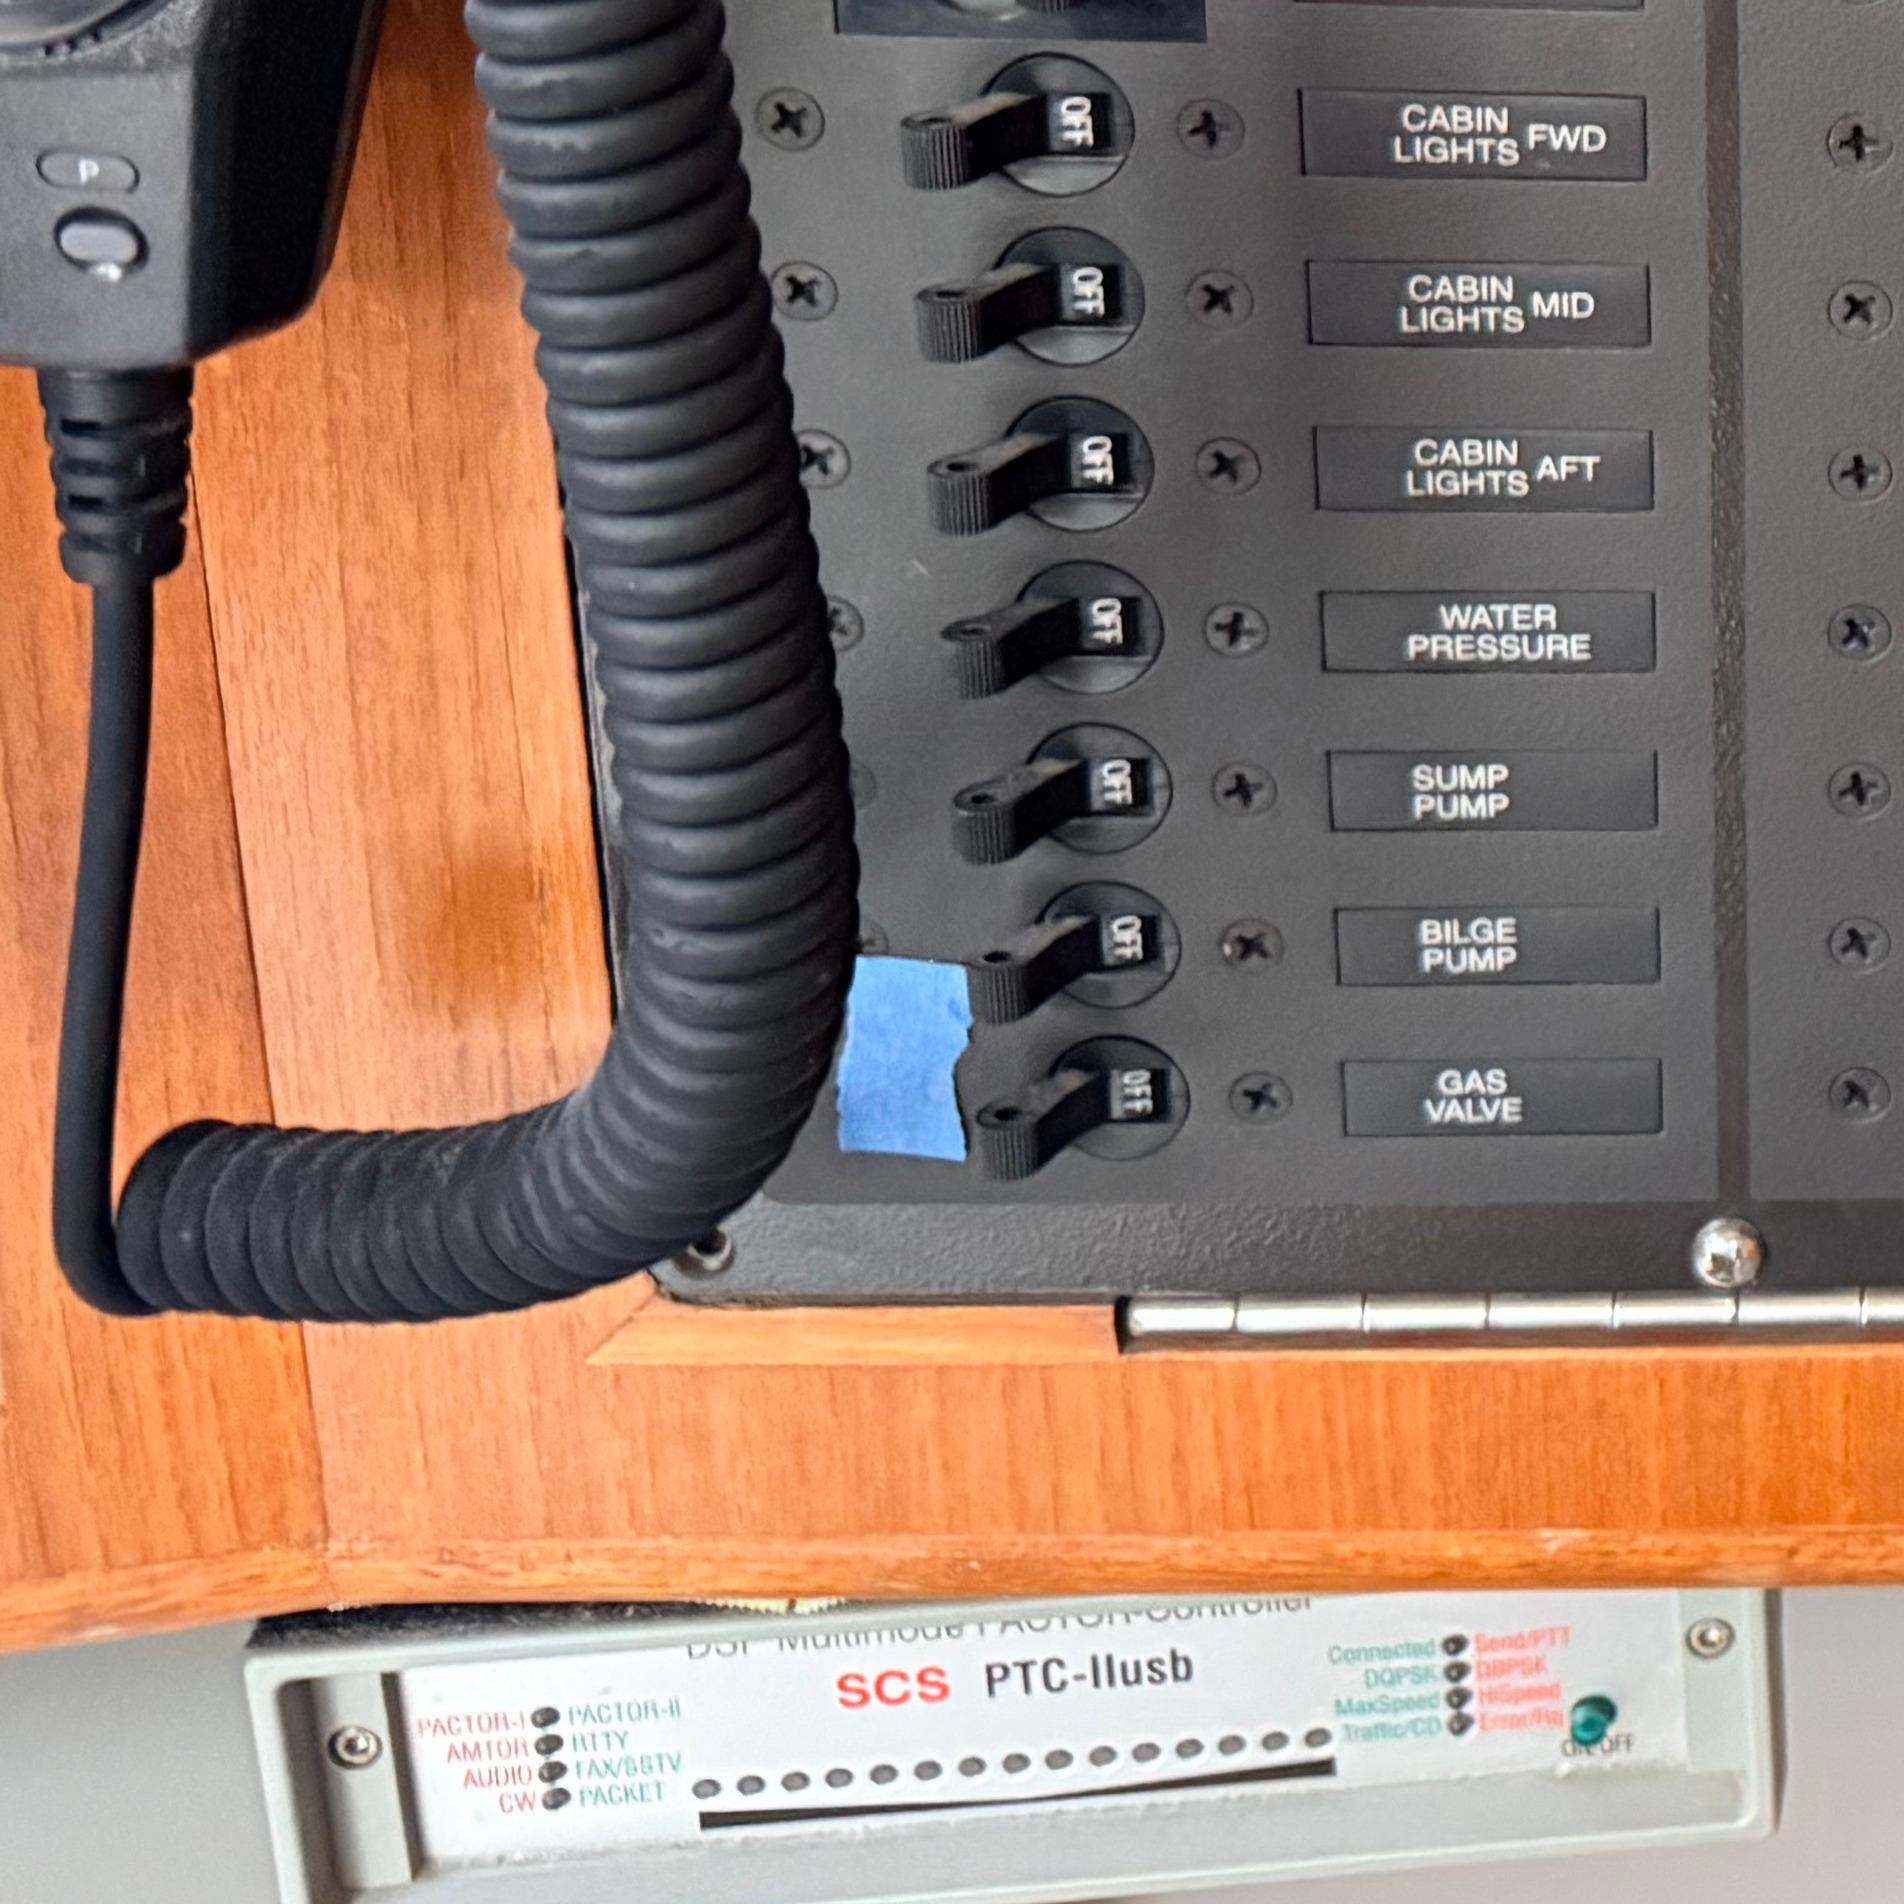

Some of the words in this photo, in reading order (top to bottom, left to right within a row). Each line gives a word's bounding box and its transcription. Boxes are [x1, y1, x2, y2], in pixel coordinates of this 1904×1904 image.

[1402, 104, 1509, 134] CABIN
[1393, 135, 1520, 166] LIGHTS
[1527, 123, 1606, 154] FWD
[1408, 274, 1514, 304] CABIN
[1400, 304, 1525, 333] LIGHTS
[1531, 291, 1595, 320] MID
[1413, 438, 1518, 467] CABIN
[1405, 467, 1529, 497] LIGHTS
[1536, 456, 1602, 483] AFT
[1439, 604, 1558, 632] WATER
[1408, 632, 1592, 662] PRESSURE
[1411, 764, 1510, 792] SUMP
[1413, 792, 1510, 821] PUMP
[1419, 917, 1518, 947] BILGE
[1421, 947, 1517, 975] PUMP
[1437, 1069, 1508, 1096] GAS
[1424, 1096, 1522, 1125] VALVE
[1328, 1638, 1436, 1665] Connected
[836, 1667, 950, 1709] SCS
[463, 1765, 533, 1789] AUDIO
[499, 1791, 537, 1814] CW
[578, 1781, 666, 1807] PACKET
